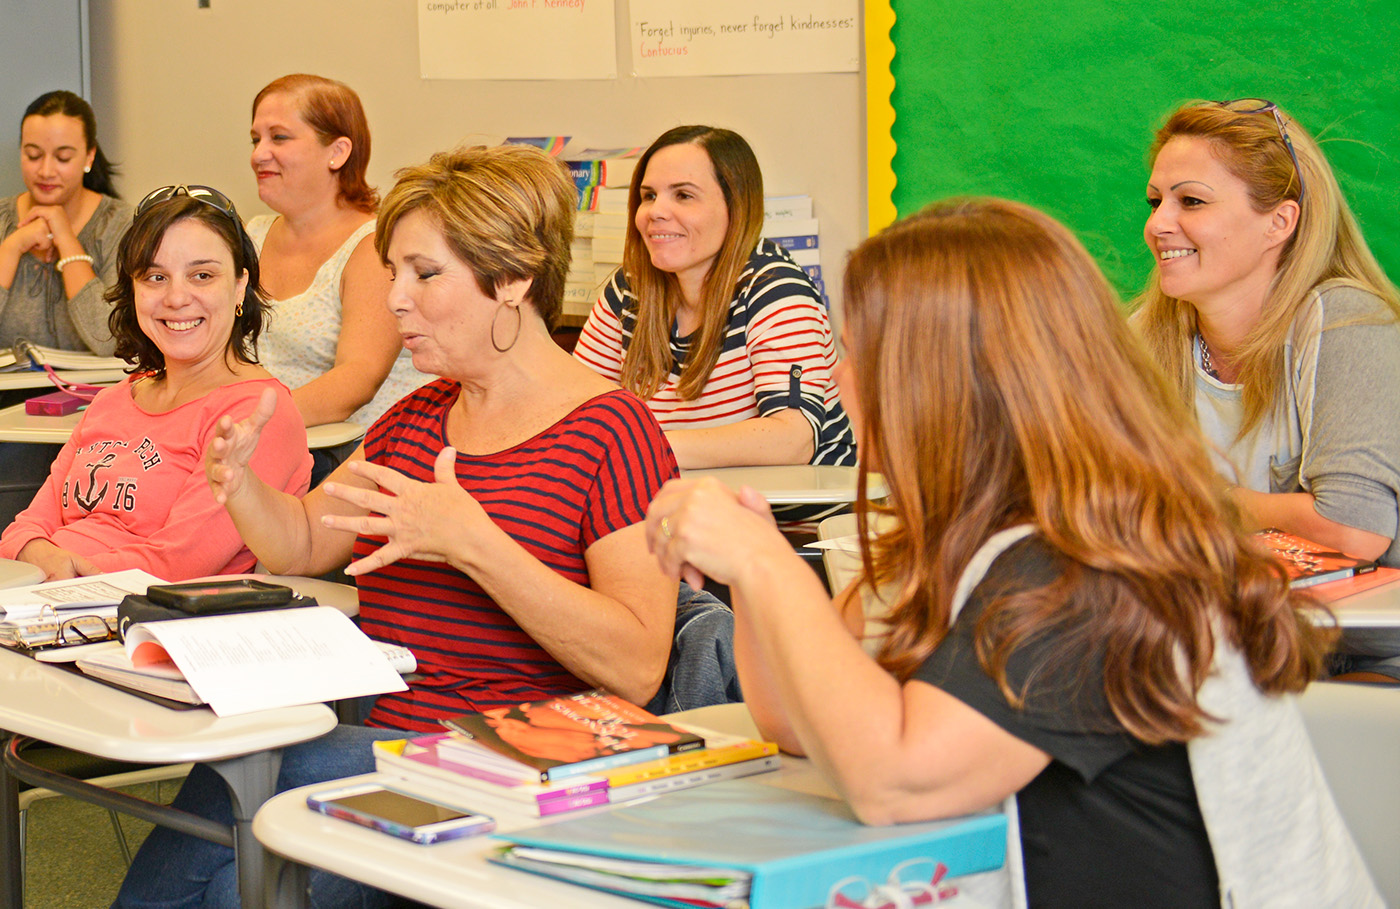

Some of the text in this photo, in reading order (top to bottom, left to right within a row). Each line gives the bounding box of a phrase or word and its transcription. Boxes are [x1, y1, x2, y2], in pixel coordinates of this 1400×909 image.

[427, 0, 470, 14] computer
[473, 0, 484, 10] of
[544, 0, 586, 14] Kennedy
[720, 23, 748, 33] never
[753, 14, 784, 39] forget
[640, 41, 689, 58] Confucius
[112, 482, 138, 512] 76
